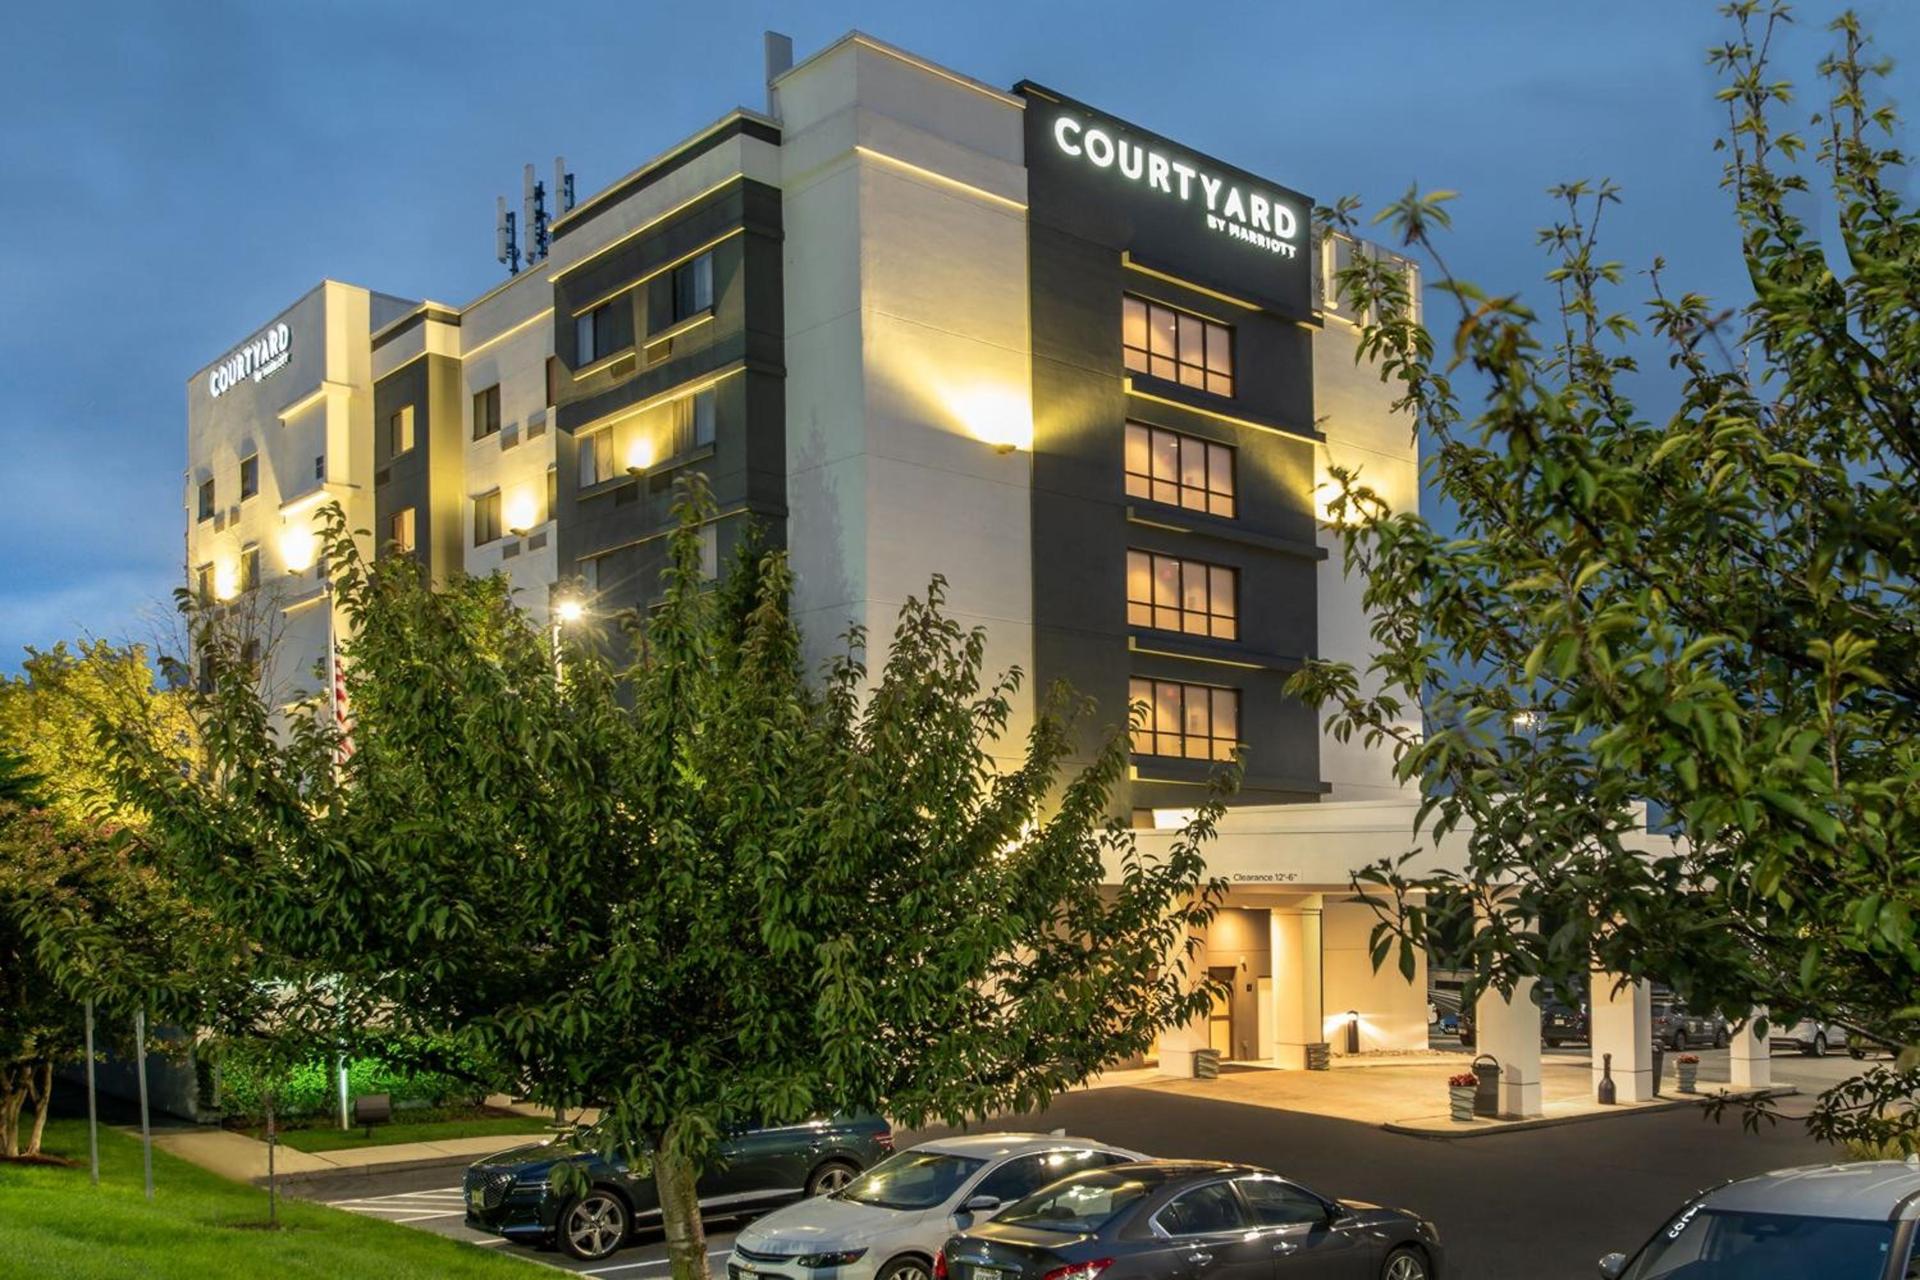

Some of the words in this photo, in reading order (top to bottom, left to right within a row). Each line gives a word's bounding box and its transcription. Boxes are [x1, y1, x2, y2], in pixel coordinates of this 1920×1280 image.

[1054, 117, 1297, 238] COURTYARD
[1207, 213, 1226, 232] BY
[1228, 222, 1297, 259] MARRIOTT
[210, 322, 289, 398] COURTYARD
[1233, 873, 1273, 881] Clearance
